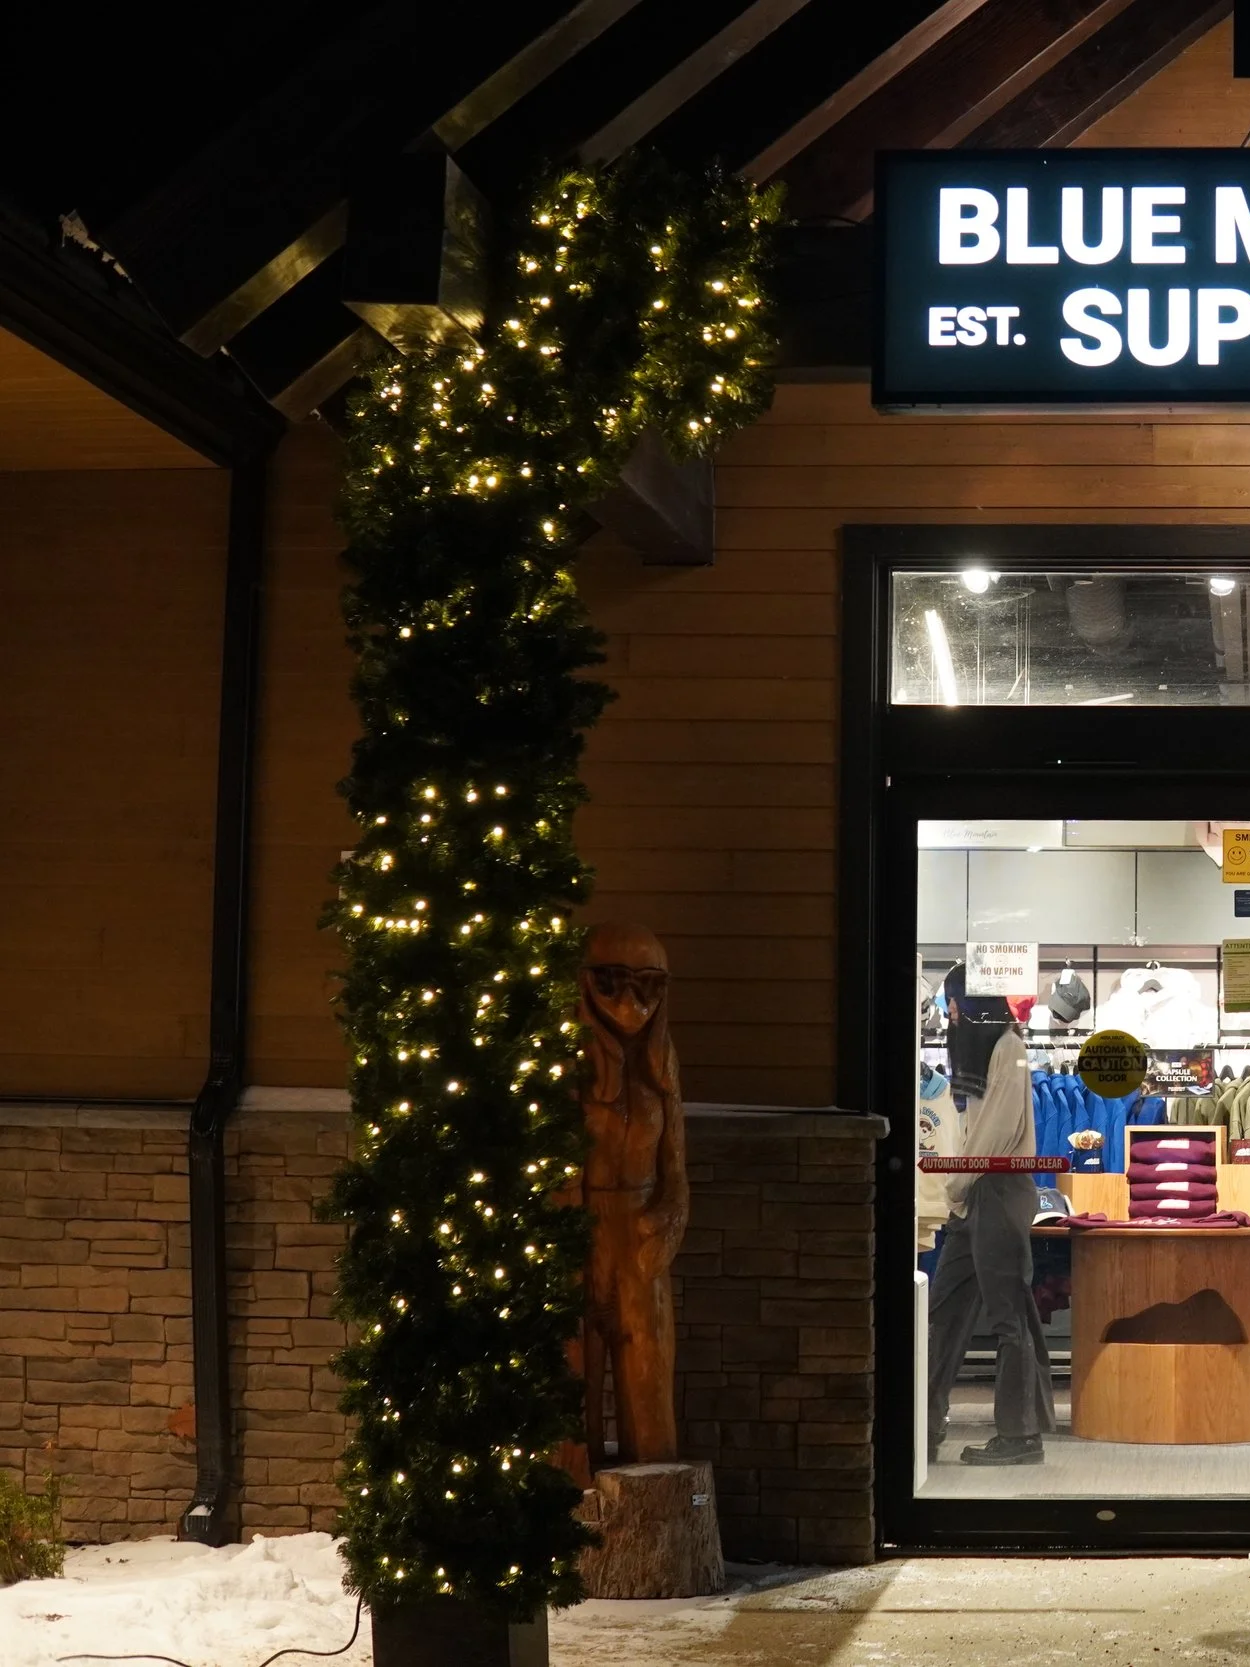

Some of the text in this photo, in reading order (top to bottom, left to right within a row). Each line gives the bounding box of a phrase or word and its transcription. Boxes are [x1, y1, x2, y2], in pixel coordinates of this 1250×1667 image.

[939, 187, 1186, 265] BLUE
[929, 307, 1026, 347] EST.
[976, 945, 1028, 953] NO SMOKING
[980, 967, 1024, 976] NO VAPING
[1085, 1045, 1140, 1054] AUTOMATIC
[1082, 1057, 1144, 1070] CAUTION
[1098, 1073, 1127, 1082] DOOR
[922, 1159, 1063, 1169] AUTOMATIC DOOR STAND CLEAR
